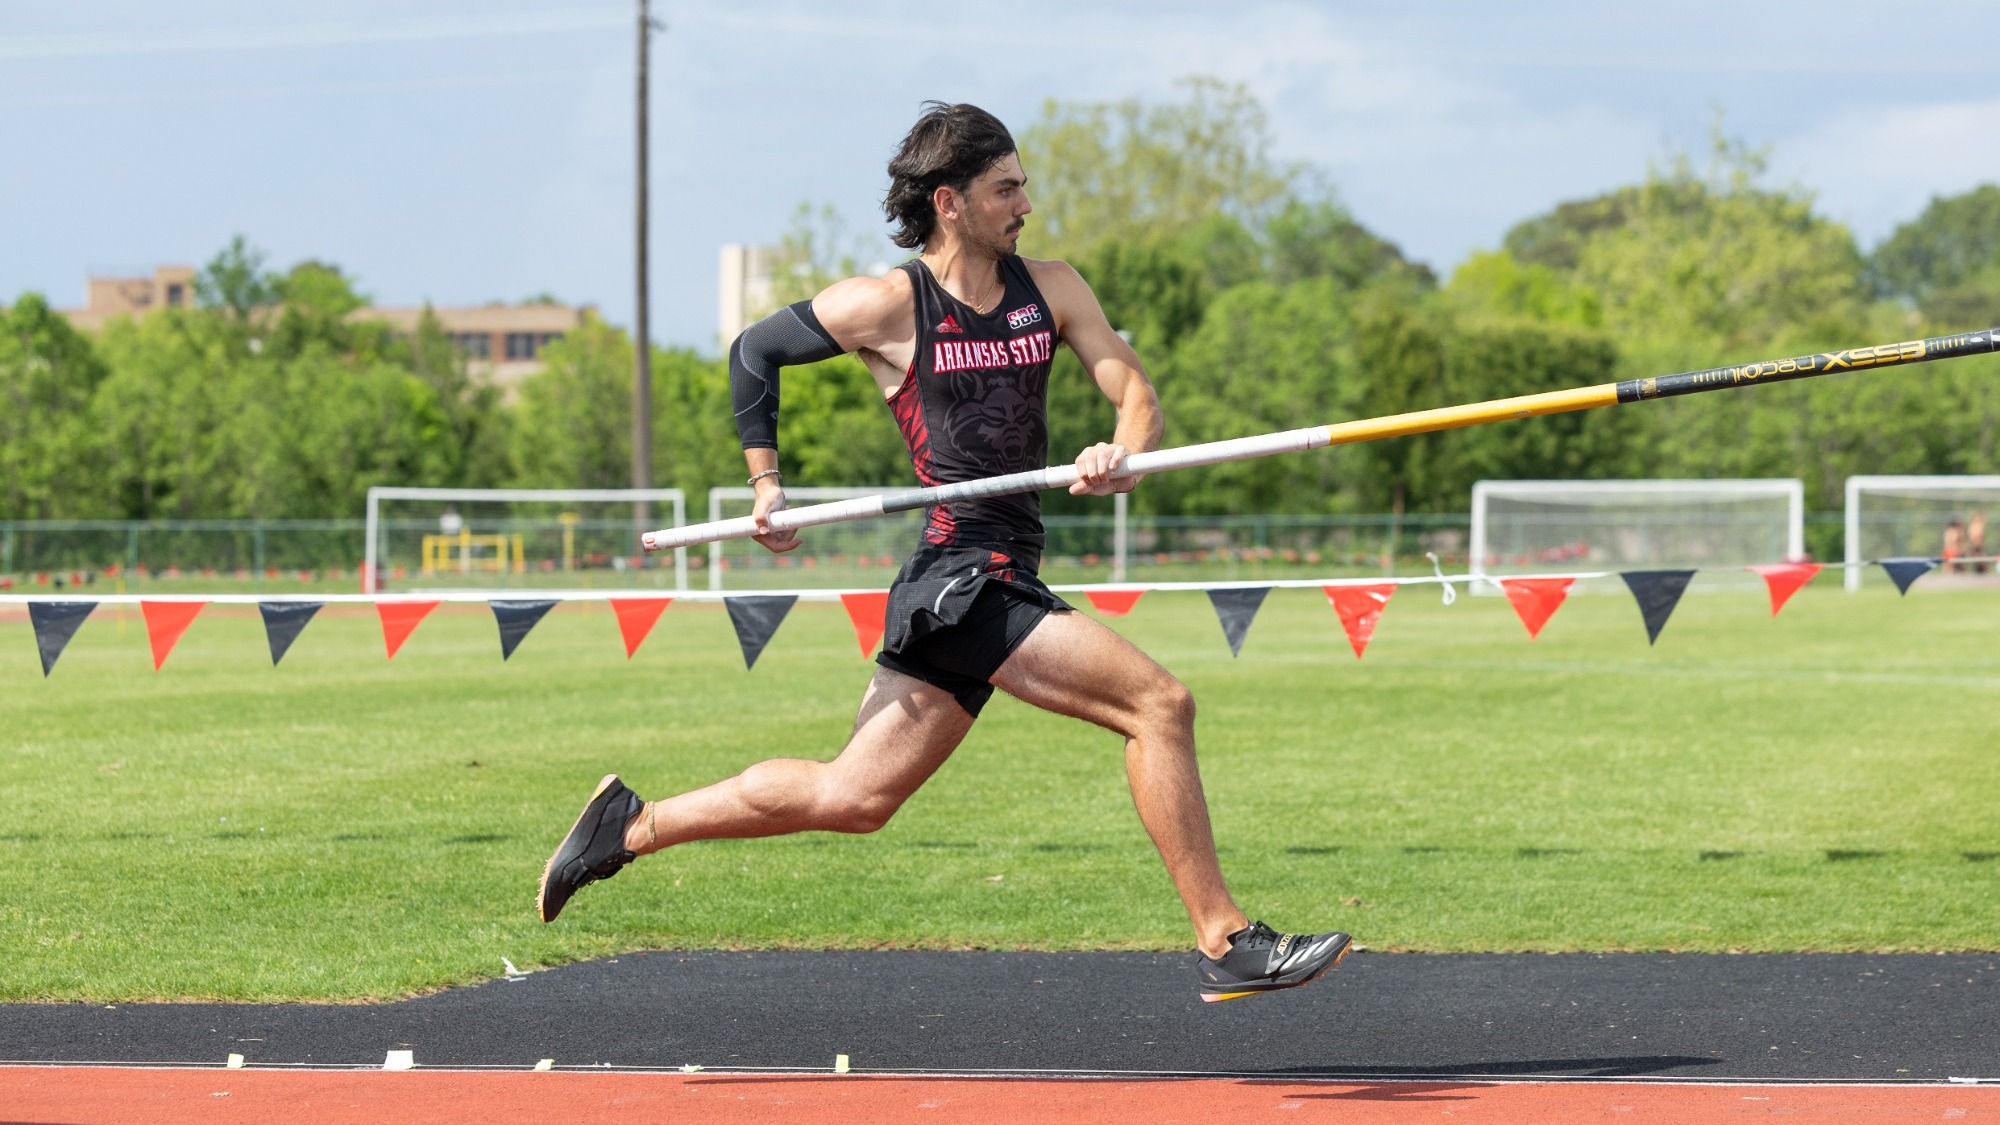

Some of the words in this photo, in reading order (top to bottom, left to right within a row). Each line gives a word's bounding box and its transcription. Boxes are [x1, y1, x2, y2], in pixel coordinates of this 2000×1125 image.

[1007, 304, 1041, 329] SBC
[934, 341, 1009, 373] ARKANSAS
[1009, 331, 1052, 365] STATE
[1821, 340, 1926, 371] ESSX
